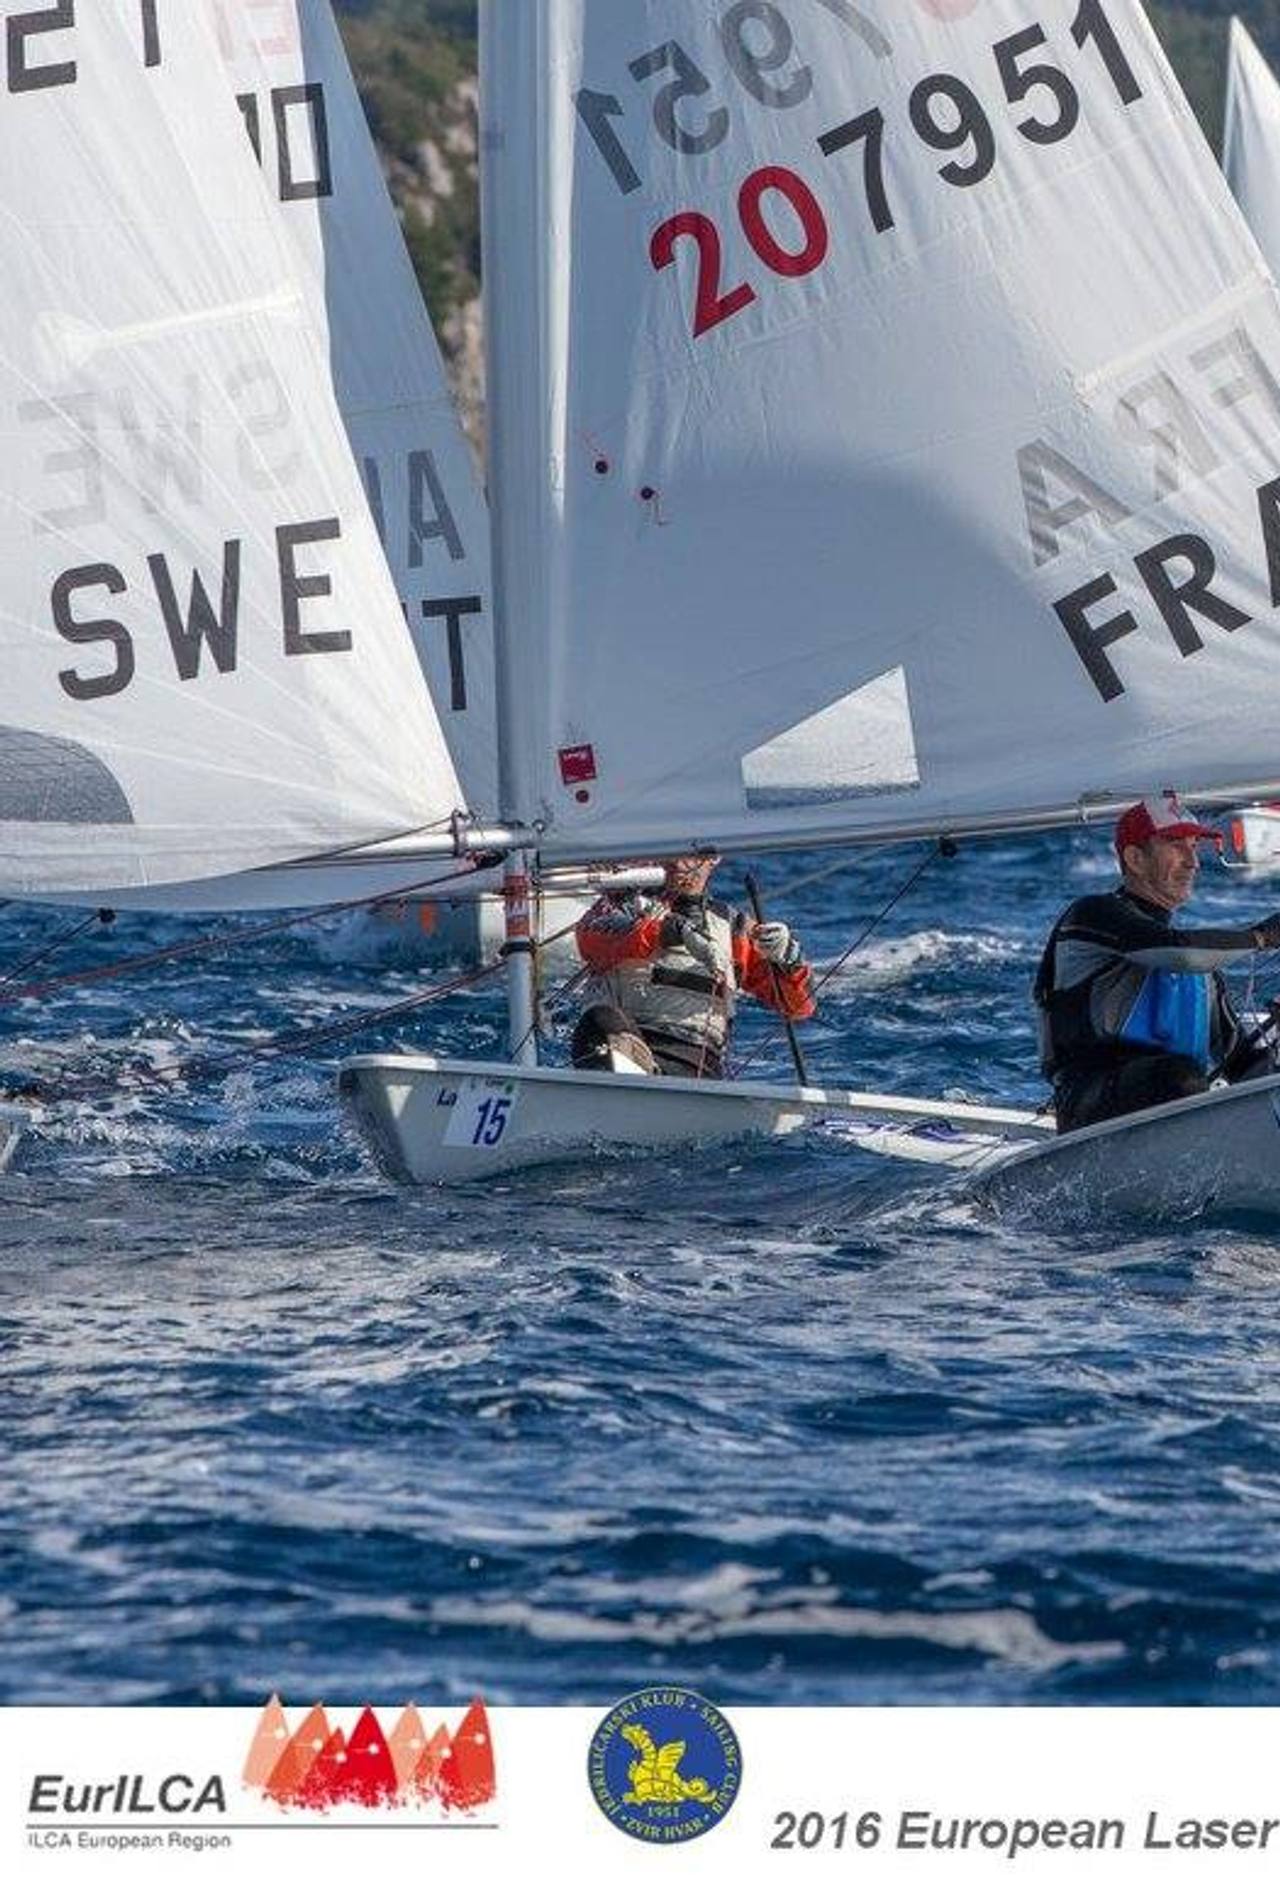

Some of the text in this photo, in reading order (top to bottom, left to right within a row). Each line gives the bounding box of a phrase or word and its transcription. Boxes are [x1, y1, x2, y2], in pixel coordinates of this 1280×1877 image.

[650, 0, 1143, 338] 207951
[50, 517, 353, 701] SWE
[472, 1098, 511, 1145] 15
